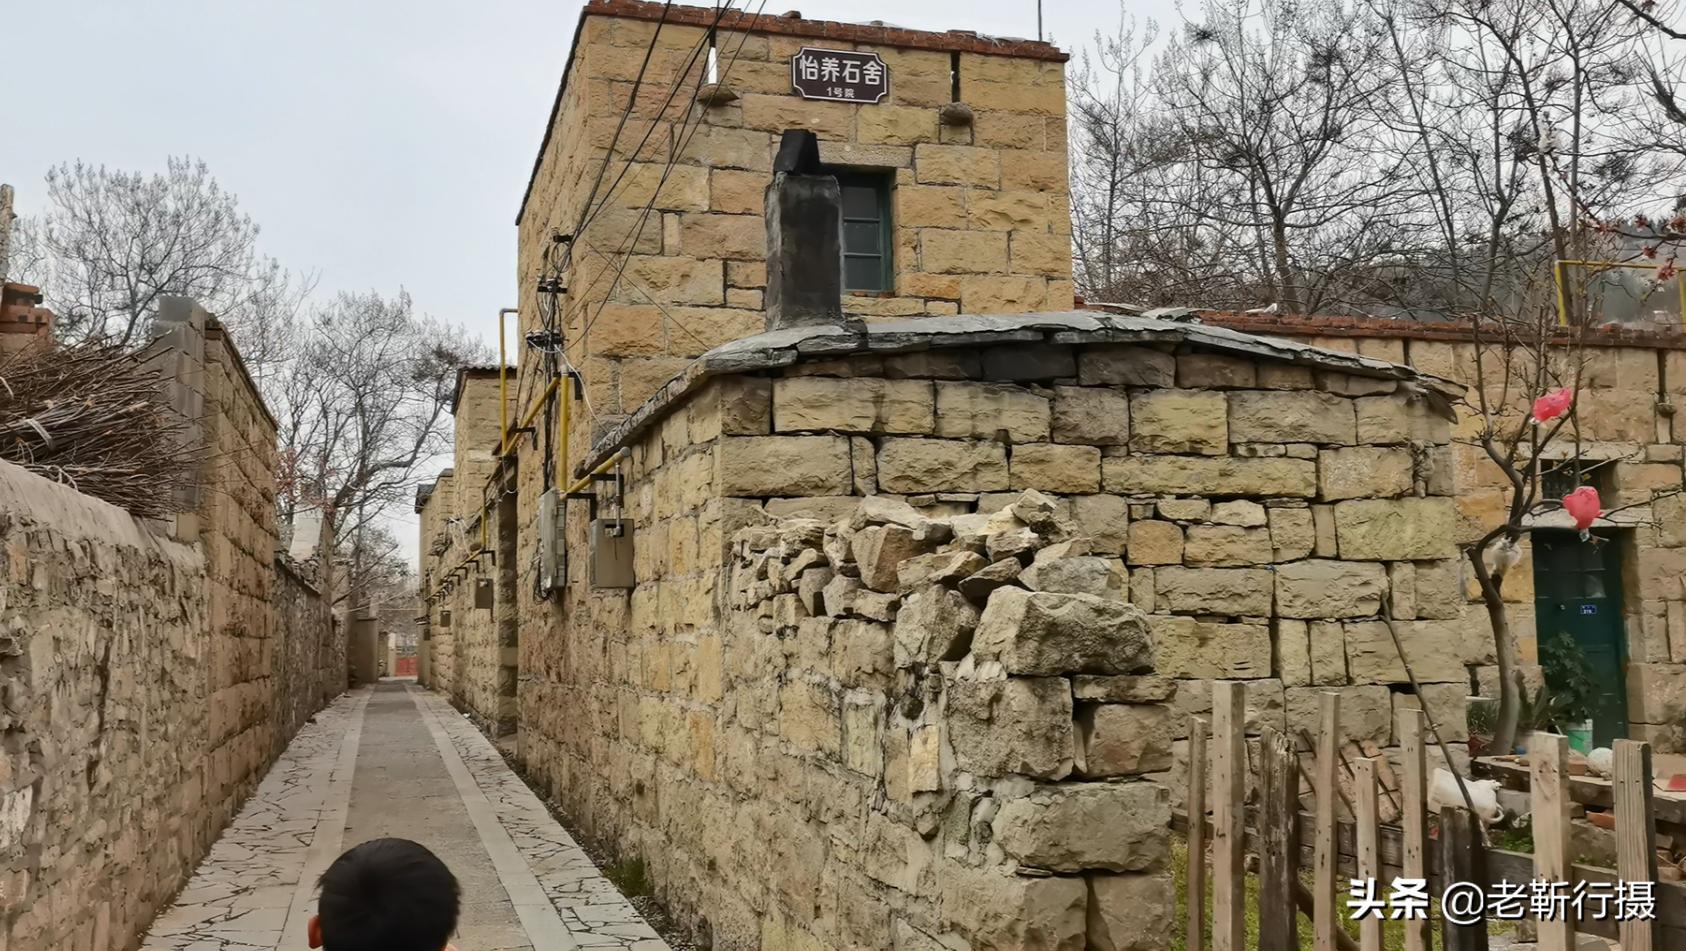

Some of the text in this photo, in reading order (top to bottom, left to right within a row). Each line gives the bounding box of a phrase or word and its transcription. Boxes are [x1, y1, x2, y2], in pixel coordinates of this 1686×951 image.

[799, 55, 882, 85] 怡养石舍
[826, 87, 855, 98] 1号院
